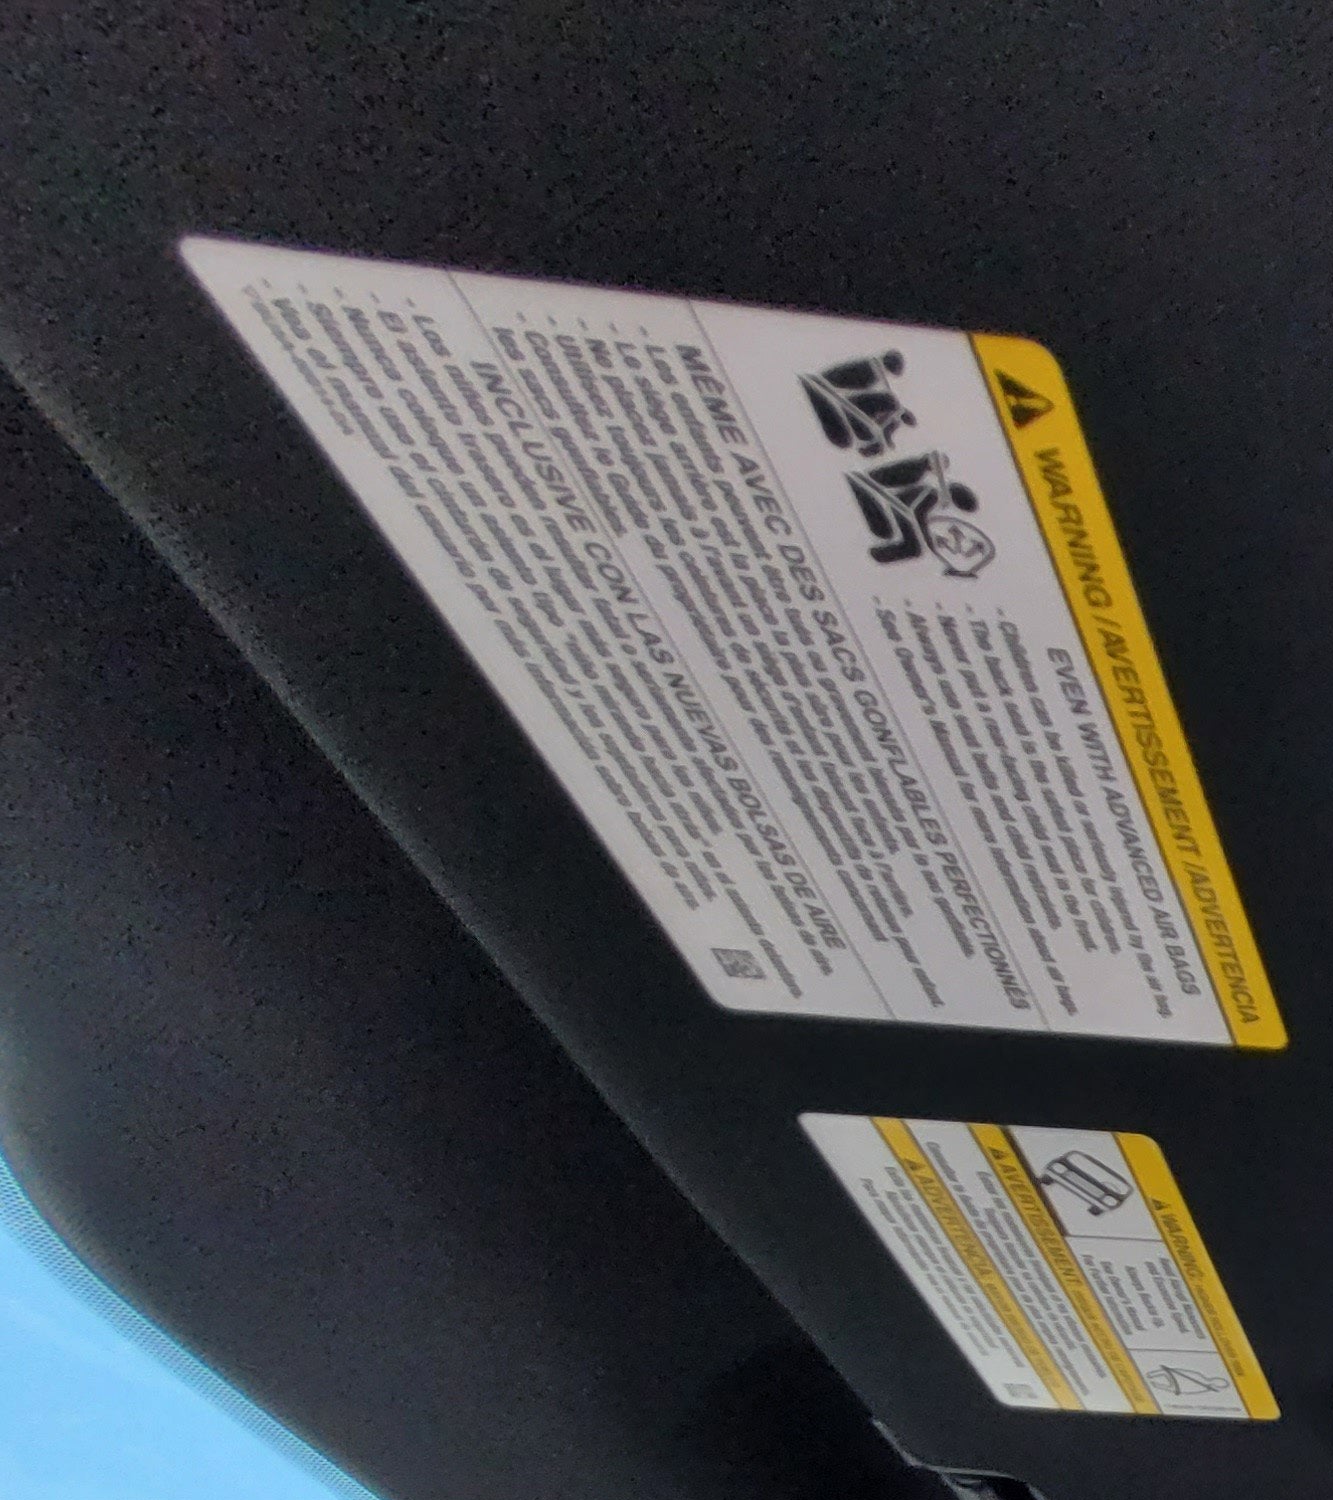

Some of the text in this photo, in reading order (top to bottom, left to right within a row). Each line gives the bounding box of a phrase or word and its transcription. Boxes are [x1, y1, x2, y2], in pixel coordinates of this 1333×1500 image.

[467, 361, 847, 949] INCLUSIVE CON LAS NUEVAS BOLSAS DE AIRE
[673, 344, 1035, 1009] MÊME AVEC DES SACS GONFLABLES PERFECTIONNÉS
[1032, 447, 1116, 609] WARNING
[1044, 647, 1201, 994] EVEN WITH ADVANCED AIR BAGS
